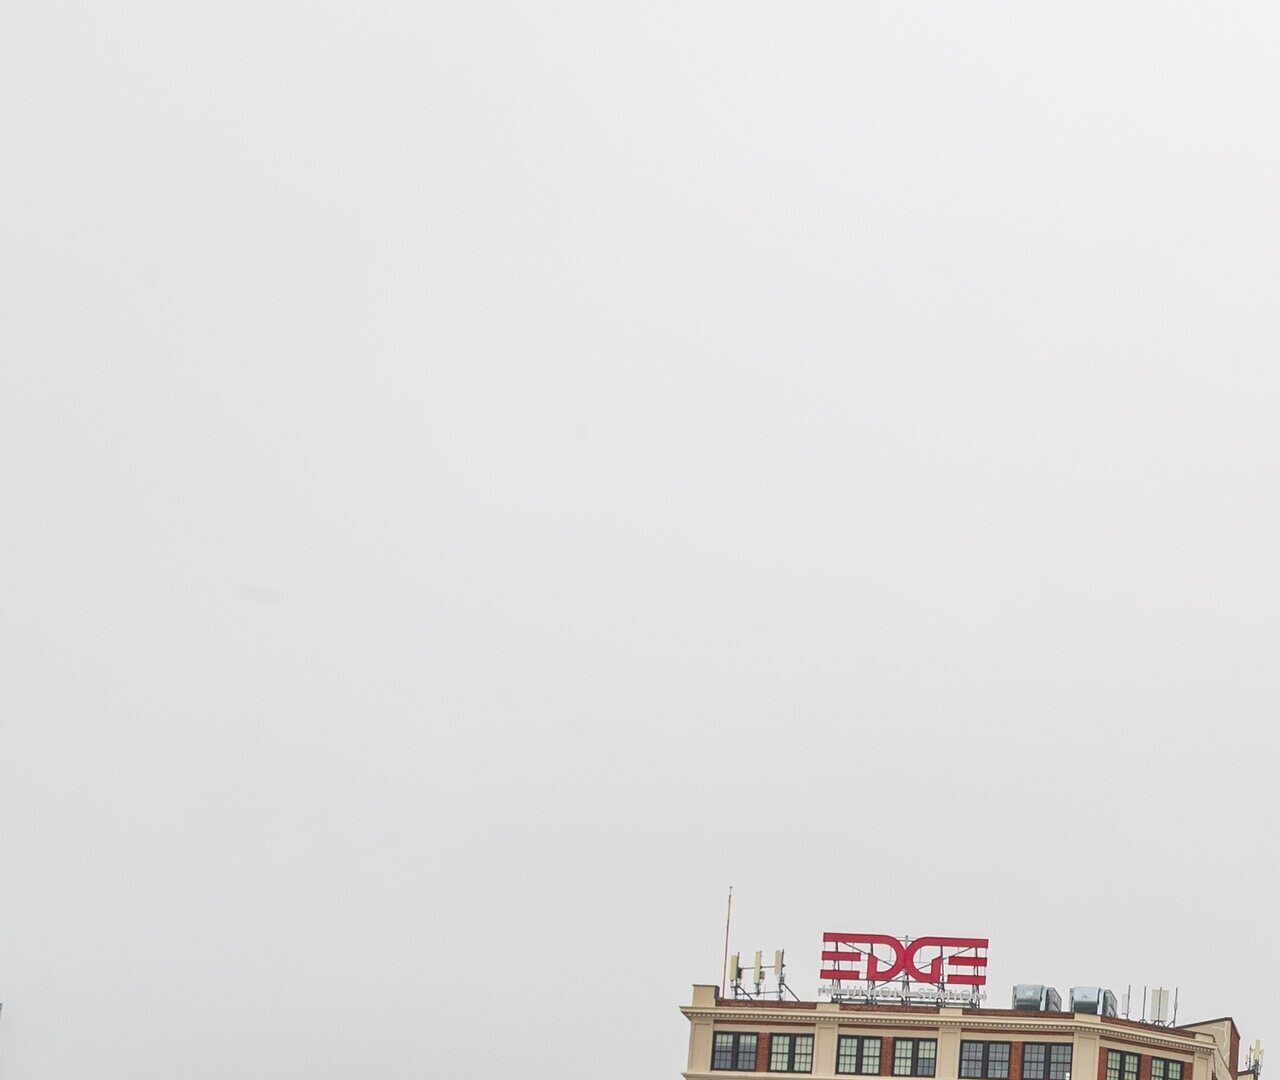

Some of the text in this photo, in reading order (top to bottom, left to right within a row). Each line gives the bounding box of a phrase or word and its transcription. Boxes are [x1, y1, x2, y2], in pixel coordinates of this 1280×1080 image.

[820, 932, 988, 985] EDGE
[846, 985, 907, 1000] UNION
[919, 988, 987, 1001] STATION
